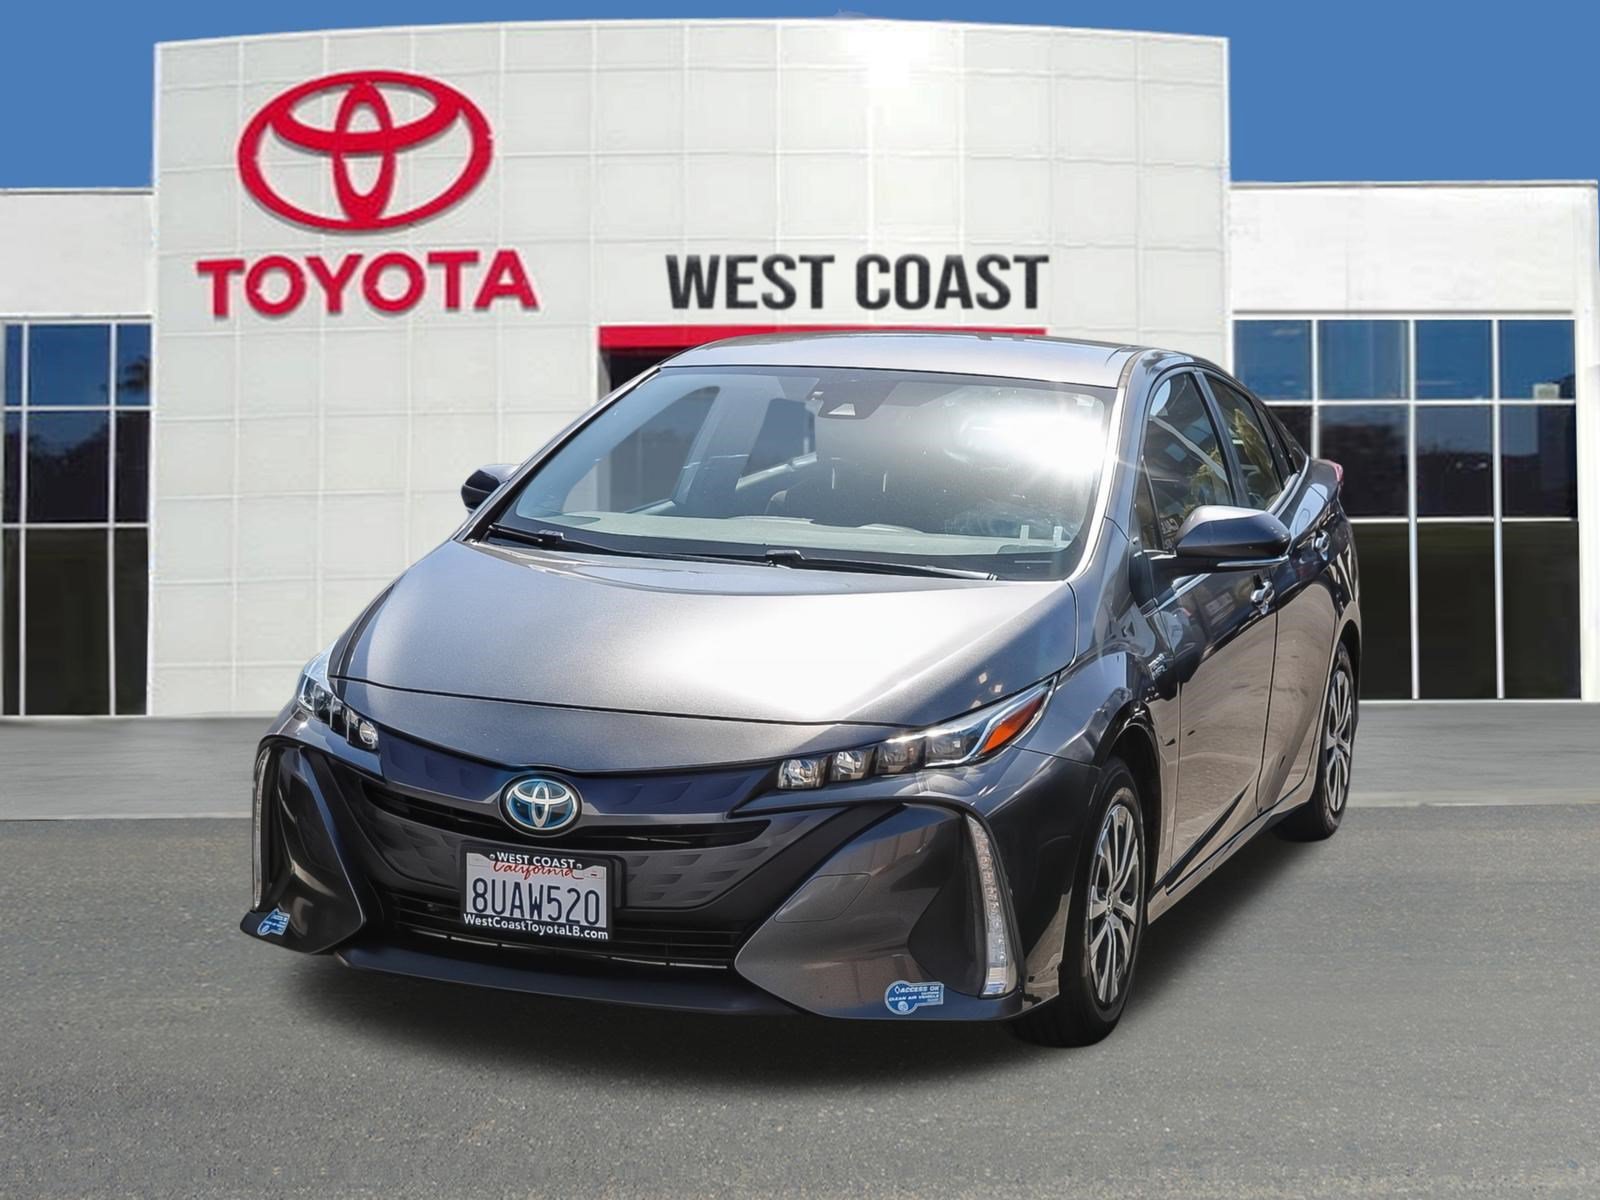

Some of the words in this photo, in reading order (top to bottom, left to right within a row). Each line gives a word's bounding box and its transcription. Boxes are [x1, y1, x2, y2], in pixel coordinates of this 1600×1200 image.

[196, 250, 539, 318] TOYOTA
[666, 254, 835, 310] WEST
[856, 254, 1049, 310] COAST
[497, 852, 529, 864] WEST
[533, 856, 575, 869] COAST
[472, 877, 600, 926] 8UAW520
[464, 914, 608, 940] WestCoastToyotaLB.com
